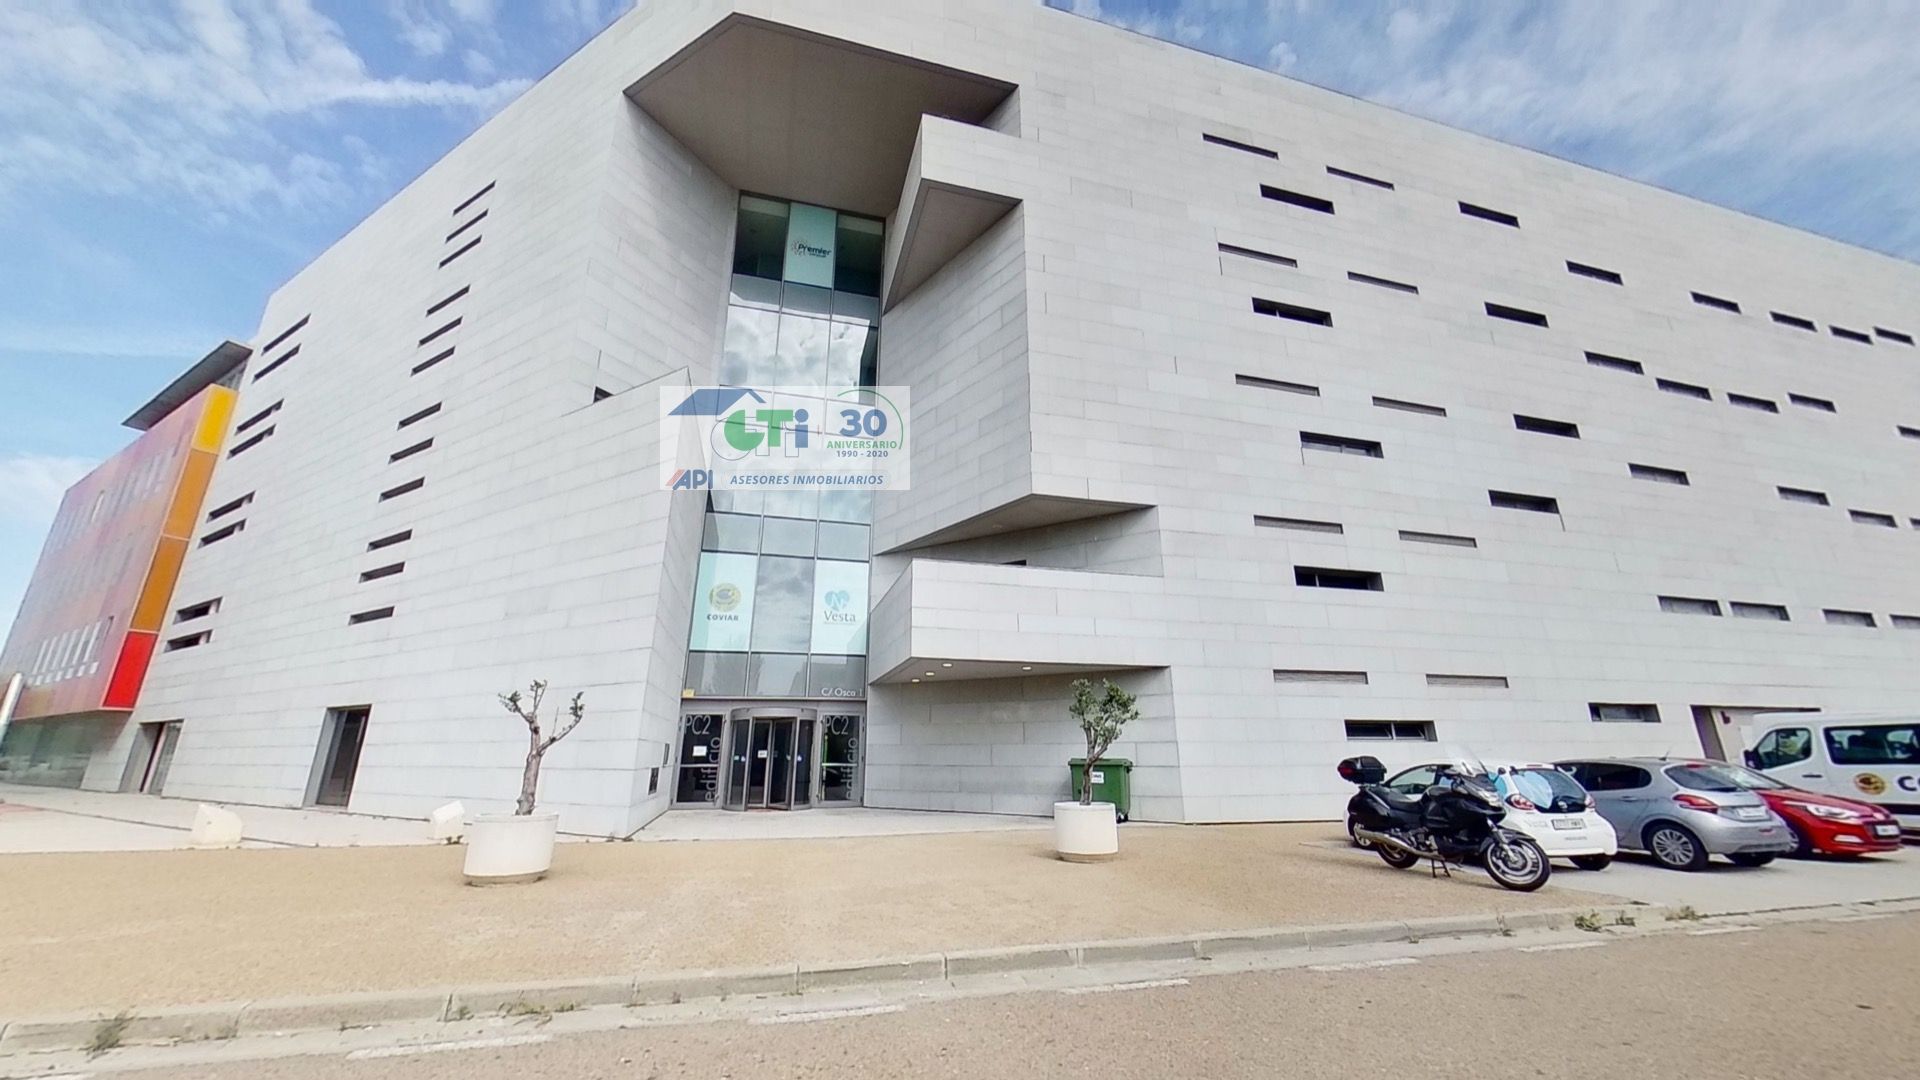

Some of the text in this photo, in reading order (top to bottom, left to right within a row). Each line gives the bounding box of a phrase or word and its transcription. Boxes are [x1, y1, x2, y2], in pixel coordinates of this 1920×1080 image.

[798, 242, 831, 256] Premier
[823, 610, 857, 622] Vesta
[684, 715, 711, 735] PC2
[825, 715, 849, 735] PC2
[700, 737, 720, 802] edifcio
[1897, 775, 1920, 792] C
